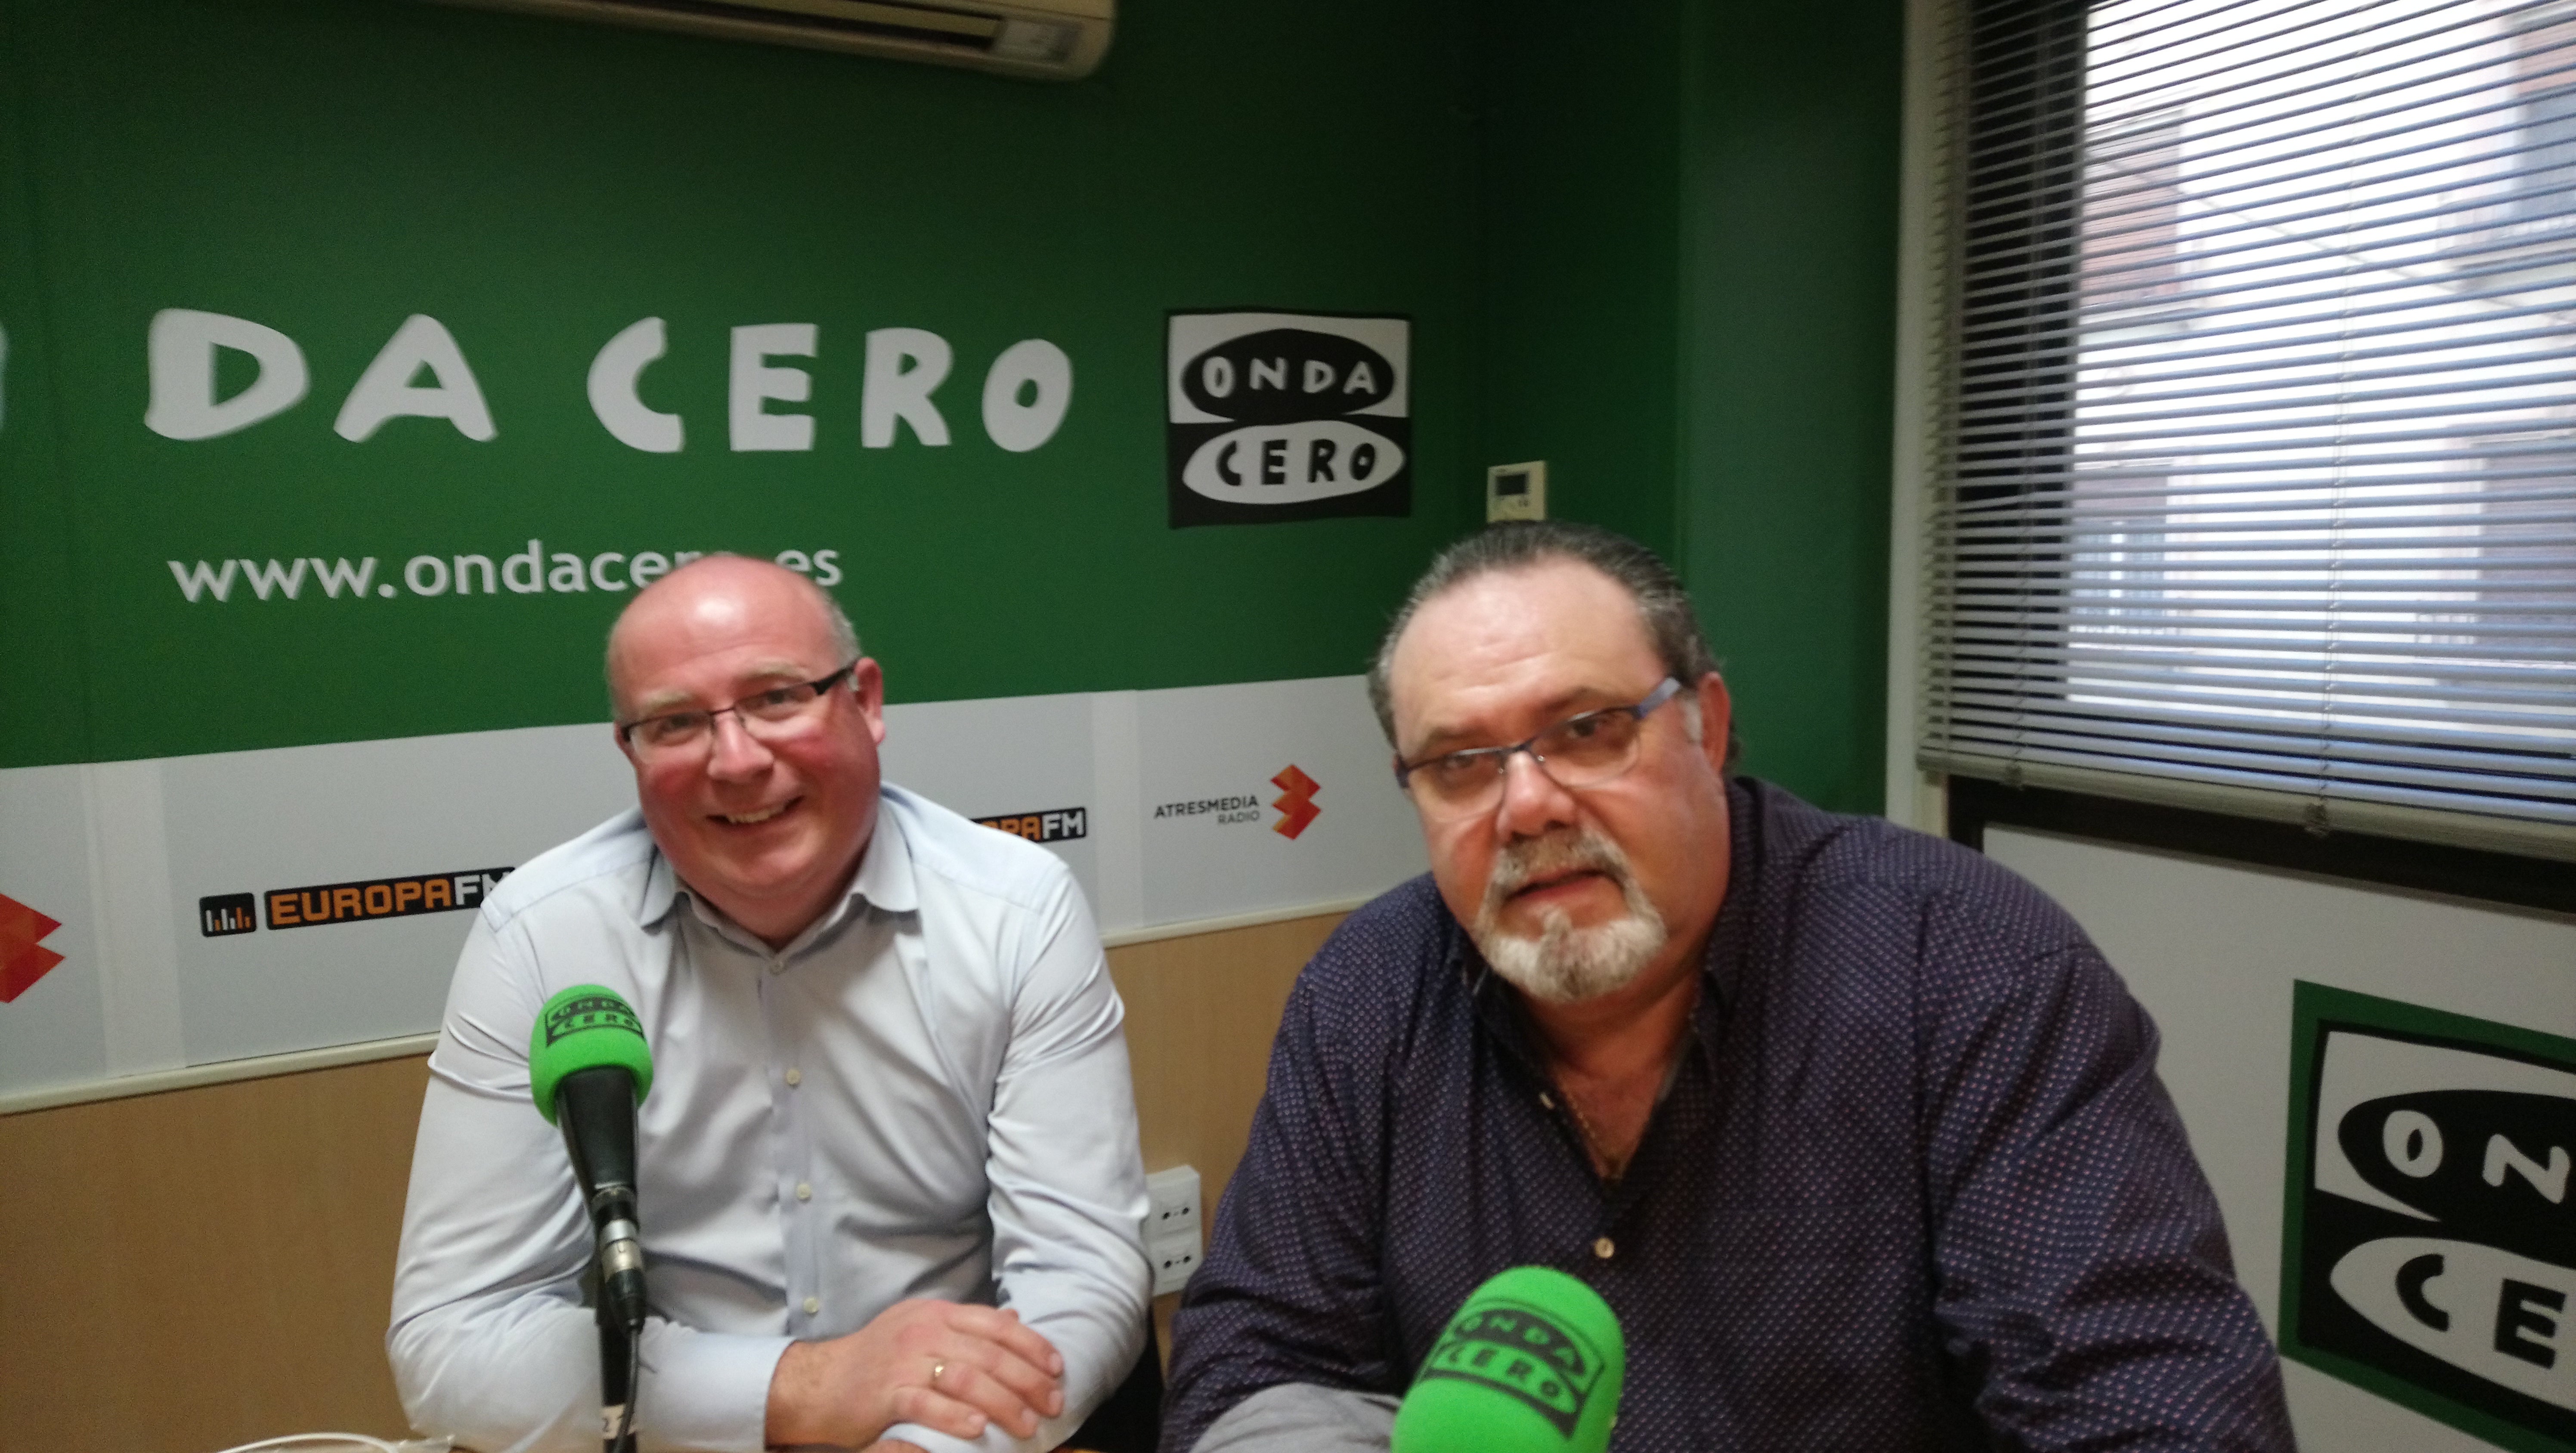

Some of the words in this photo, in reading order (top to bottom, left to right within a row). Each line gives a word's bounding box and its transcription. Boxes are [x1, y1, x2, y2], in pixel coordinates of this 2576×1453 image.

[0, 307, 499, 443] DA
[586, 315, 1073, 453] CERO
[1202, 356, 1376, 398] ONDA
[1216, 438, 1377, 487] CERO
[168, 538, 842, 603] www.ondaceres
[1153, 795, 1259, 819] ATRESMEDIA
[1217, 810, 1260, 824] RADIO
[2383, 1109, 2572, 1205] ON
[2395, 1253, 2566, 1370] CE
[1461, 1314, 1576, 1370] ONDA
